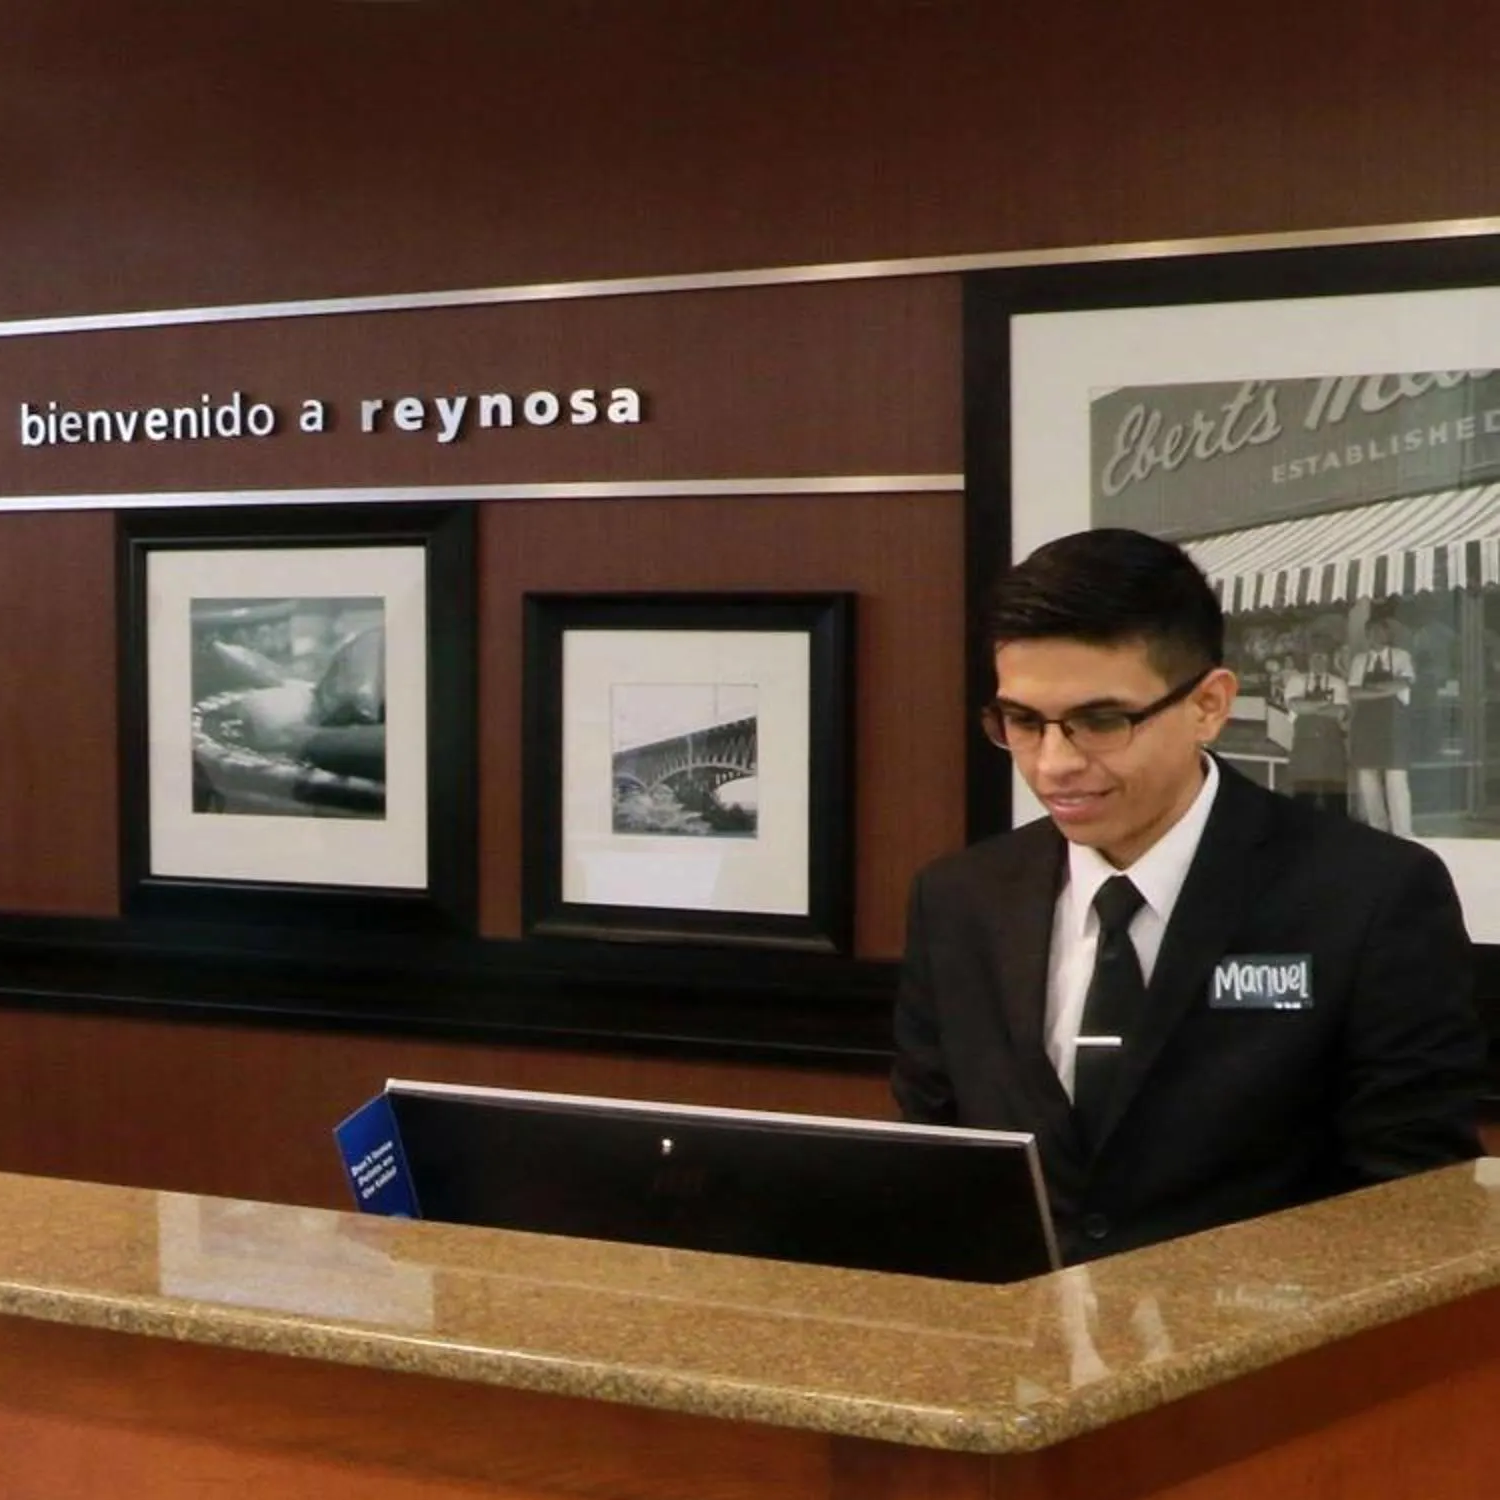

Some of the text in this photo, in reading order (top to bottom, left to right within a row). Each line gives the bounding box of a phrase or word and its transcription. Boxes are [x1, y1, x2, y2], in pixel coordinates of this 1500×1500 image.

[21, 386, 642, 447] bienvenido a reynosa
[1214, 961, 1309, 1000] Manuel
